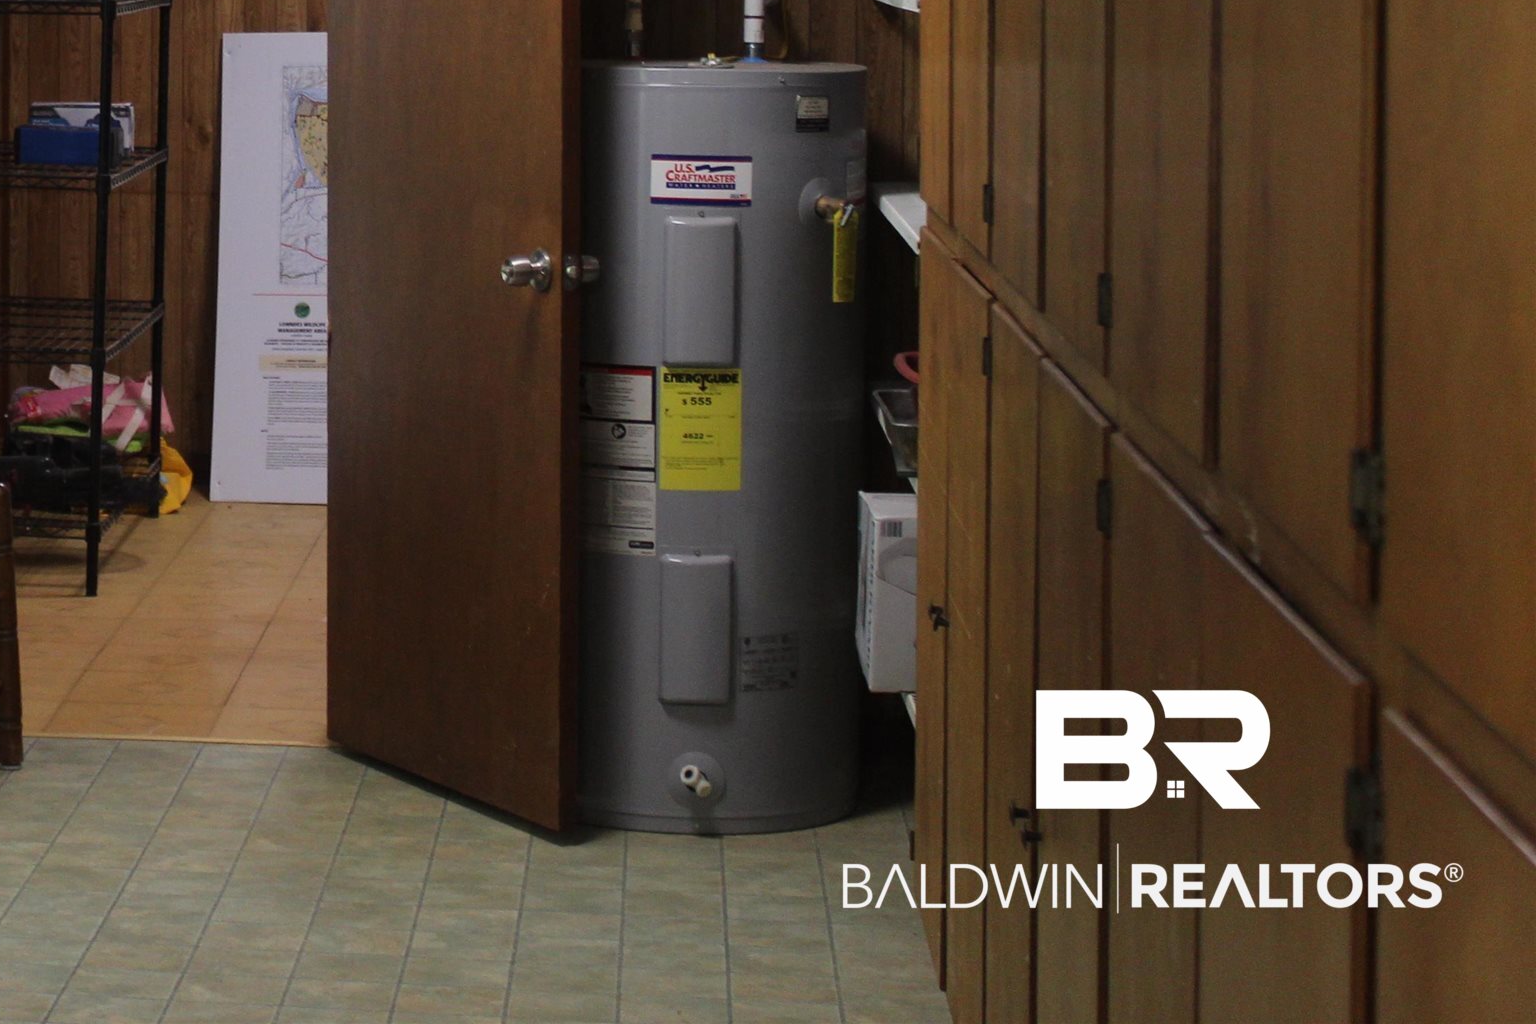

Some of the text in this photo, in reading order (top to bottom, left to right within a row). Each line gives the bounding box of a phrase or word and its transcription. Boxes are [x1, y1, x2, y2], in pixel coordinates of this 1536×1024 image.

[674, 163, 695, 174] U.S.
[665, 170, 735, 183] CRAFTMASTER
[690, 396, 711, 405] 555
